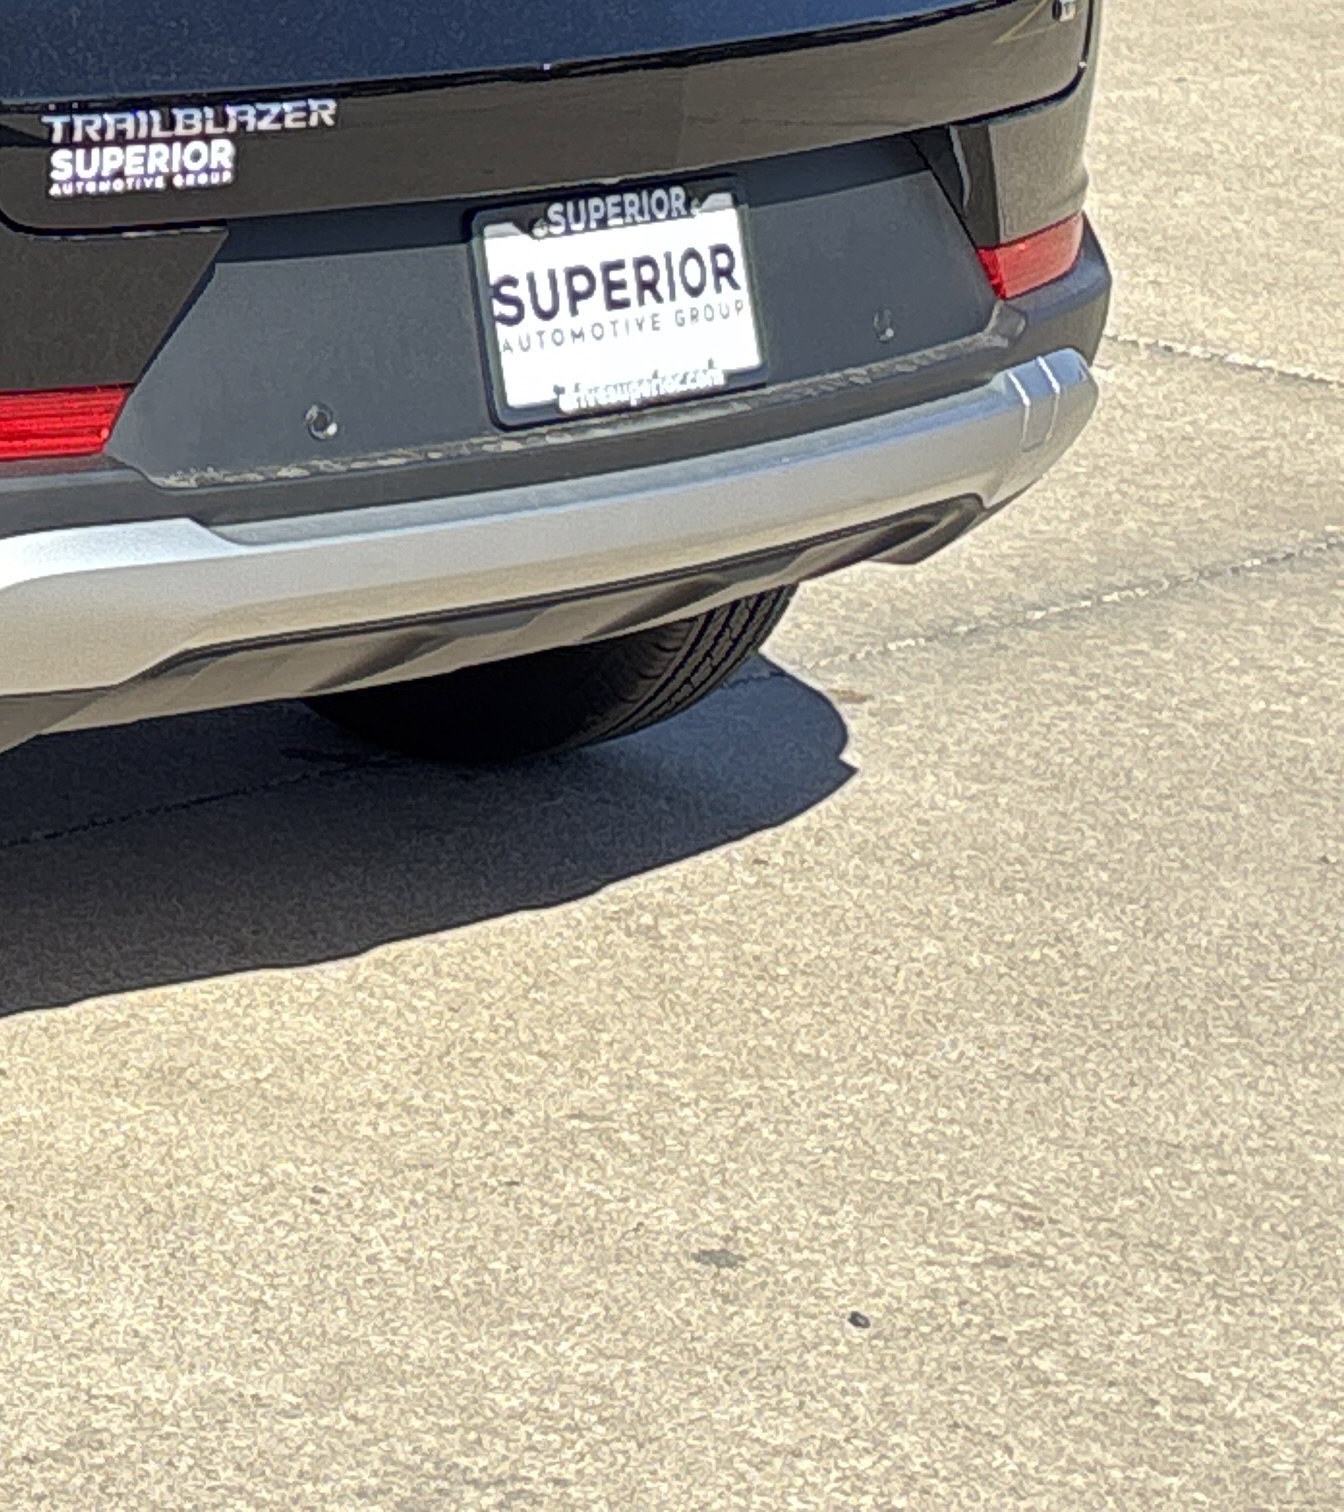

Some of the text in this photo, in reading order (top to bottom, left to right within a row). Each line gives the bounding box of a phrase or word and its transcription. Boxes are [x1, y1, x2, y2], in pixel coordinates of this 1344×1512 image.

[41, 98, 338, 144] TRAILBLAZER
[49, 170, 232, 197] AUTOMOTIVE GROUP
[50, 139, 234, 181] SUPERIOR
[547, 185, 687, 235] SUPERIOR
[490, 243, 742, 327] SUPERIOR
[502, 299, 744, 354] AUTOMOTIVE GROUP
